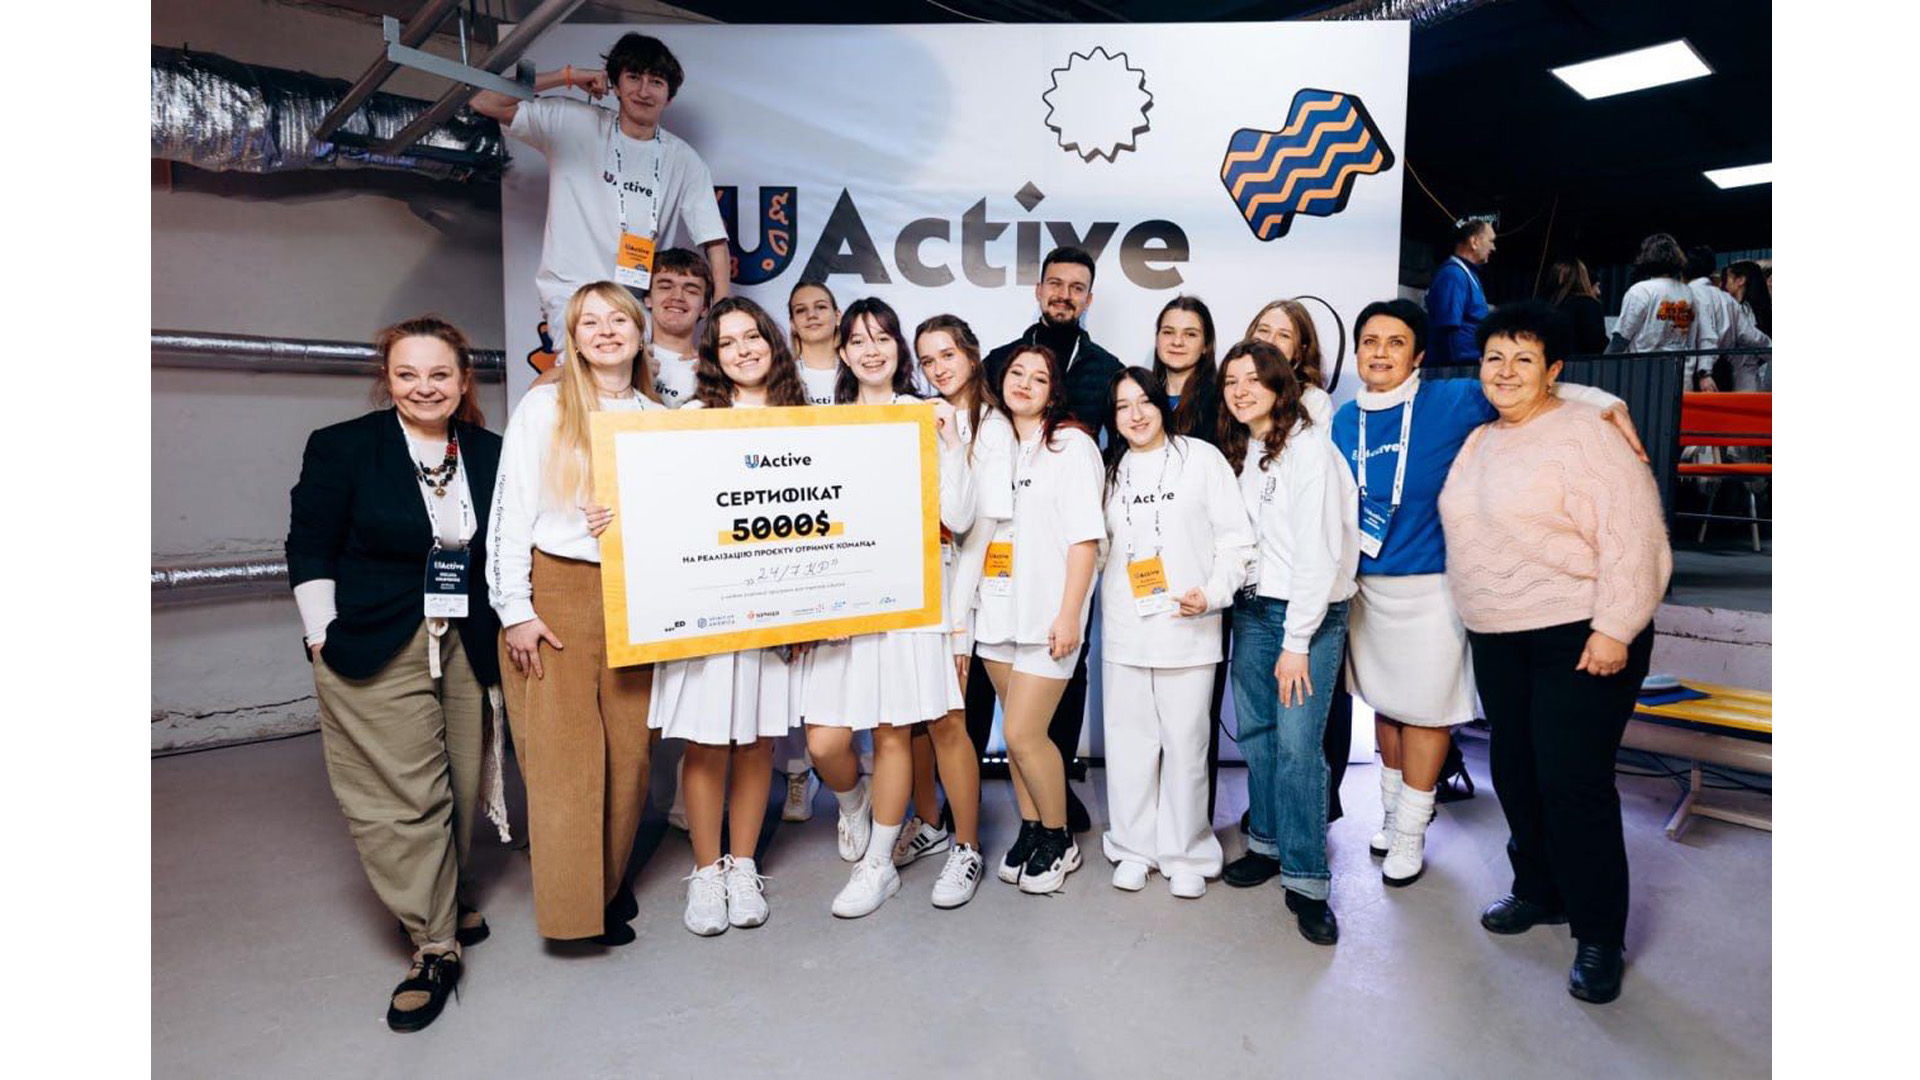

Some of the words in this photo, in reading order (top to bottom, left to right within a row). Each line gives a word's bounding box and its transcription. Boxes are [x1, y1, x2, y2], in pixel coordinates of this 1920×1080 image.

[603, 170, 653, 197] Uctive
[713, 180, 1190, 290] UActive
[656, 380, 678, 398] tive
[744, 452, 812, 469] UActive
[716, 485, 842, 507] СЕРТИФІКАТ
[732, 509, 831, 541] 5000$
[697, 551, 752, 562] РЕАЛІЗАЦІЮ
[754, 547, 793, 558] ПРОЄКТУ
[795, 543, 835, 554] ОТРИМУЄ
[837, 540, 876, 550] КОМАНДА
